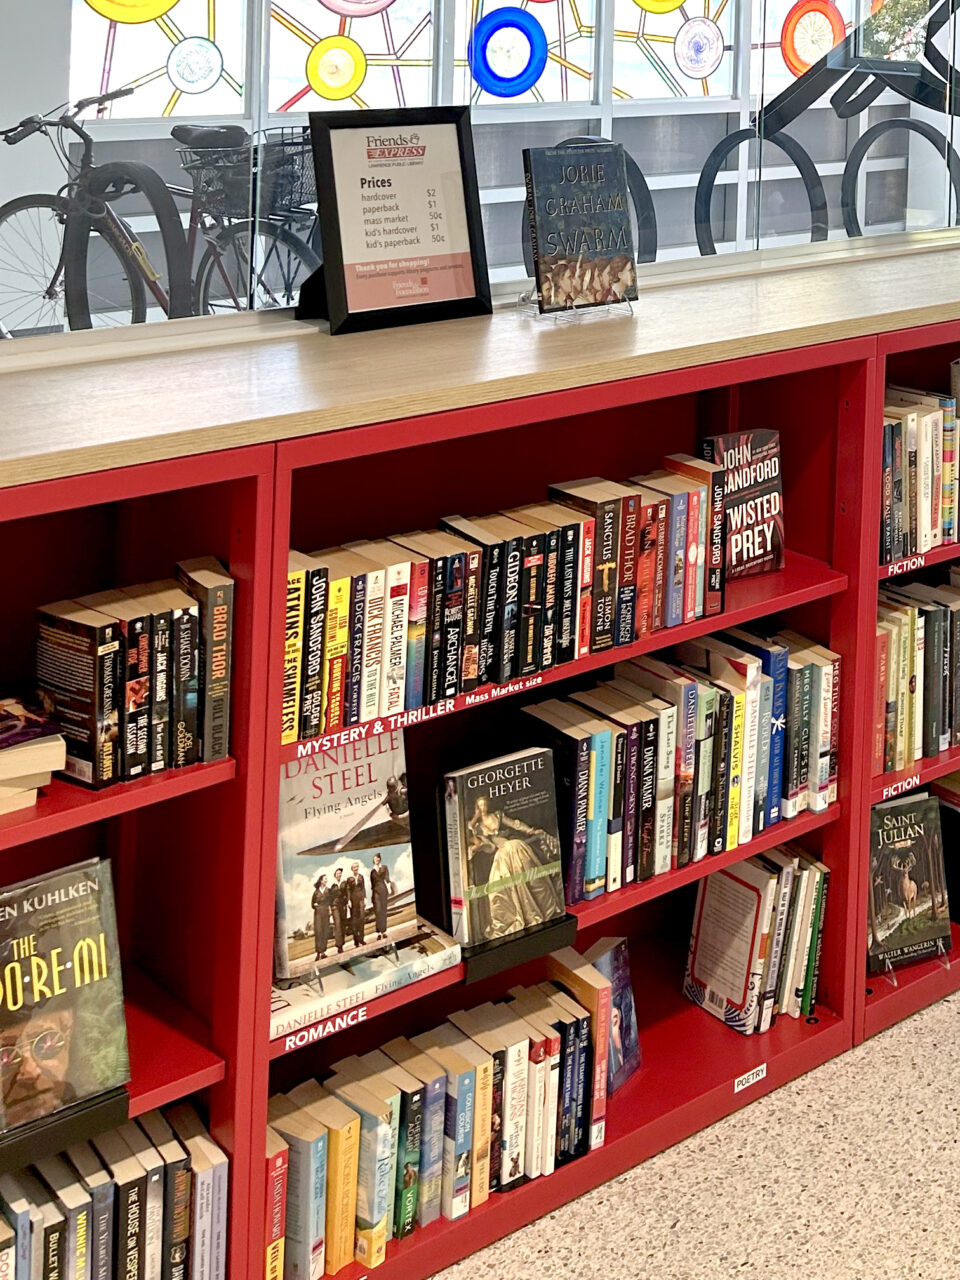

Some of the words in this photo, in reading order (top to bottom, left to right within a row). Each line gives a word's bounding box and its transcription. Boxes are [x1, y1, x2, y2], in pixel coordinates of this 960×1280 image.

[366, 135, 408, 148] Friends
[376, 146, 425, 158] EXPRESS
[360, 176, 392, 189] Prices
[559, 164, 606, 185] JORIE
[361, 193, 397, 201] hardcover
[427, 189, 436, 197] $2
[363, 203, 399, 215] paperback
[428, 200, 437, 208] $1
[545, 192, 623, 217] GRAHAM
[364, 217, 382, 225] mass
[384, 214, 408, 223] market
[364, 229, 381, 237] kid's
[383, 226, 417, 235] hardcover
[430, 223, 439, 232] $1
[366, 240, 382, 249] kid's
[384, 237, 421, 249] paperback
[547, 226, 628, 257] SWARM
[721, 443, 751, 470] JOHN
[723, 457, 779, 494] SANDFORD
[714, 485, 723, 511] JOHN
[603, 512, 613, 560] SANCTUS
[625, 515, 636, 546] BRAD
[712, 514, 722, 565] SANDFORD
[731, 520, 774, 565] PREY
[505, 551, 520, 604] GIDEON
[623, 547, 635, 582] THOR
[888, 556, 925, 575] FICTION
[311, 576, 326, 612] JOHN
[212, 604, 228, 640] BRAD
[391, 598, 404, 635] MICHAEL
[596, 598, 604, 632] TOYNE
[604, 596, 613, 629] SIMON
[138, 633, 149, 673] CHRISTOPHER
[180, 630, 190, 655] SHAKE
[308, 614, 324, 675] SANDFORD
[389, 636, 403, 668] PALMER
[445, 627, 459, 688] ARCHANGEL
[156, 652, 167, 672] JACK
[180, 655, 190, 681] DOWN
[211, 643, 227, 680] THOR
[155, 671, 167, 702] HIGGINS
[388, 686, 400, 711] FATAL
[211, 698, 224, 724] FULL
[297, 725, 368, 758] MYSTERY
[373, 719, 384, 734] &
[390, 699, 455, 730] THRILLER
[466, 693, 488, 705] Mass
[491, 683, 524, 698] Market
[525, 676, 543, 686] size
[303, 694, 312, 716] PREY
[311, 691, 321, 725] GOLDEN
[126, 722, 137, 755] ASSASSIN
[211, 724, 223, 757] BLACK
[282, 729, 400, 780] DANIELLE
[643, 746, 654, 775] DIANA
[311, 763, 378, 800] STEEL
[467, 757, 545, 790] GEORGETTE
[489, 777, 532, 798] HEYER
[578, 770, 589, 799] DIANA
[883, 774, 920, 799] FICTION
[303, 801, 341, 820] Flying
[344, 789, 383, 809] Angels
[641, 775, 653, 810] PALMER
[576, 799, 587, 834] PALMER
[883, 812, 917, 827] SAINT
[877, 824, 924, 848] JULIAN
[0, 901, 18, 921] EN
[23, 877, 100, 915] KUHLKEN
[11, 934, 37, 960] THE
[878, 949, 902, 961] WALTER
[903, 941, 935, 956] WANGERIN
[274, 1003, 332, 1037] DANIELLE
[336, 990, 366, 1012] STEEL
[374, 978, 402, 996] Flying
[407, 964, 435, 985] Angels
[285, 1006, 367, 1051] ROMANCE
[736, 1065, 765, 1089] POETRY
[404, 1191, 414, 1232] VORTEX
[76, 1211, 87, 1255] WINNIE
[48, 1231, 61, 1267] BULLET
